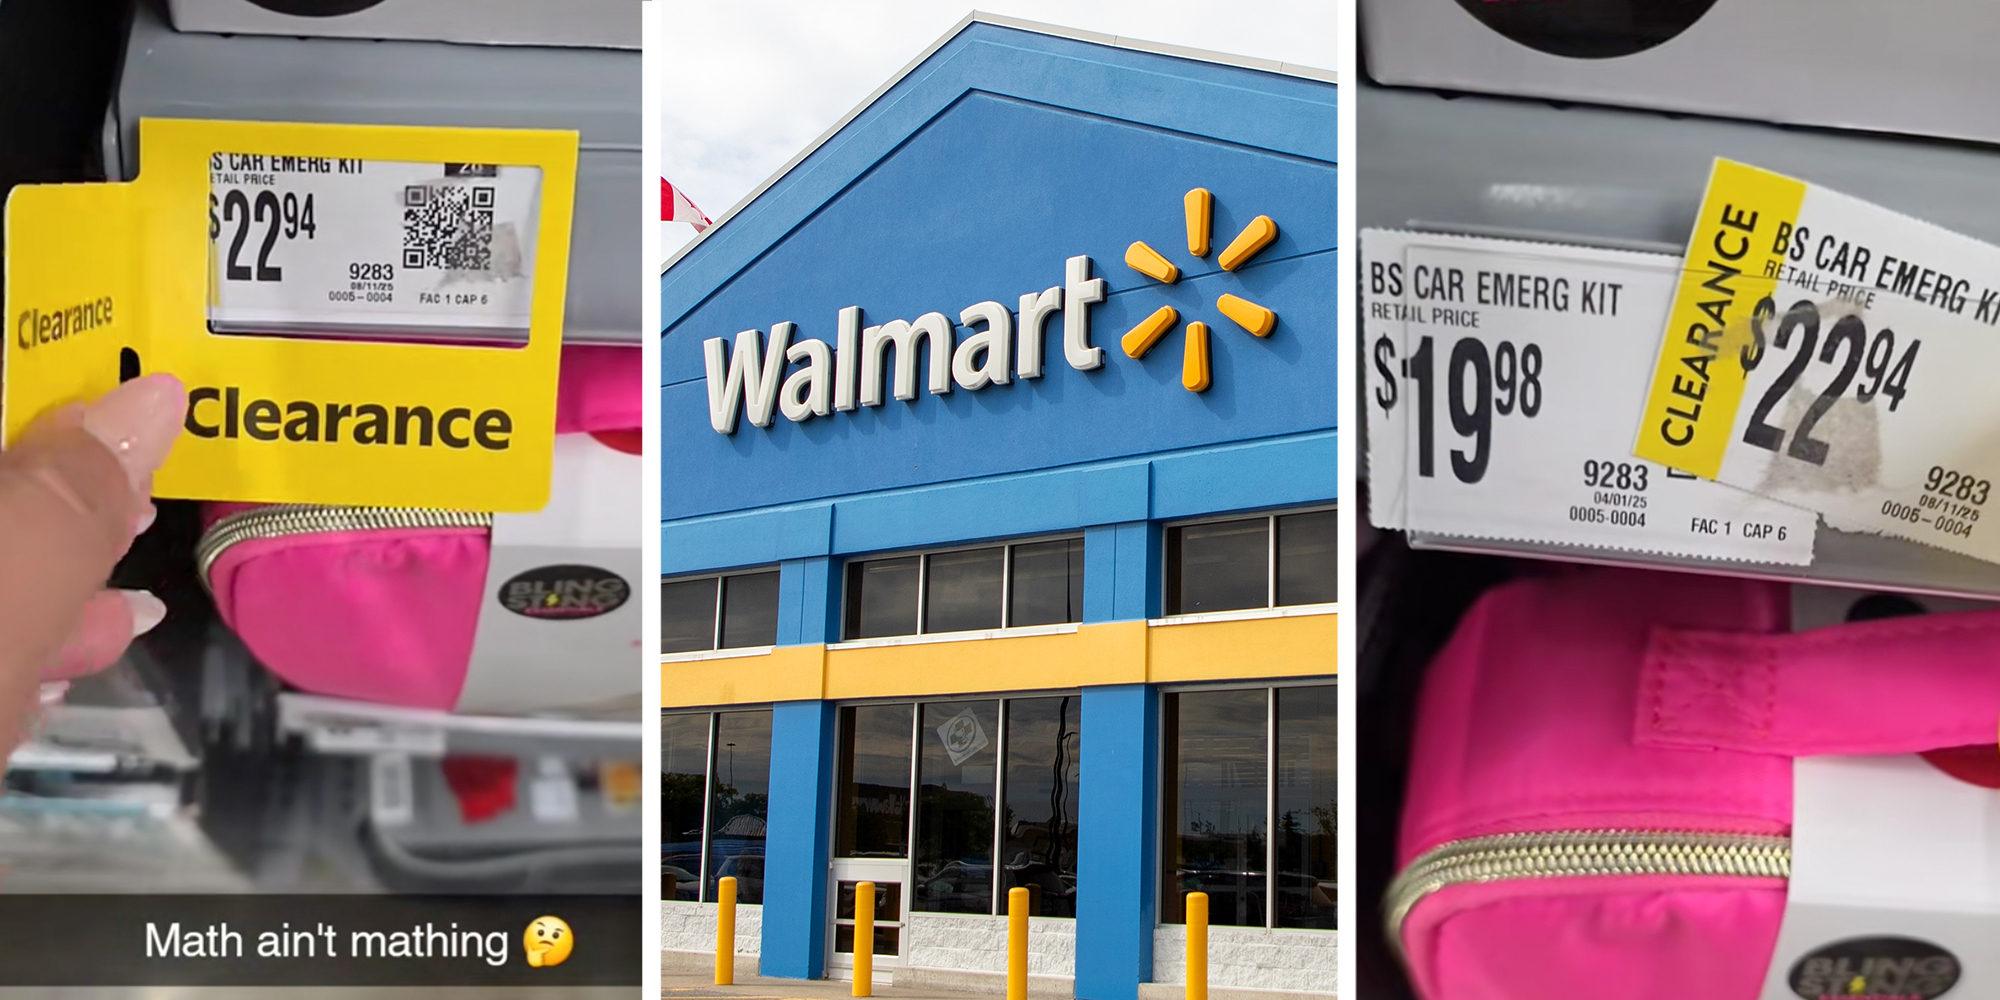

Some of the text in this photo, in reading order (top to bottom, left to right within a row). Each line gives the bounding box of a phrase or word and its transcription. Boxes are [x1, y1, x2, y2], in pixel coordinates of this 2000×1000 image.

[209, 152, 223, 171] S
[229, 153, 264, 172] CAR
[209, 173, 276, 185] ETAIL PRICE
[349, 263, 394, 281] 9283
[1763, 260, 1876, 310] RETAIL PRICE
[1772, 221, 2000, 326] BS CAR EMERG KI
[419, 293, 488, 305] FAC 1 CAP 6
[1371, 261, 1623, 316] BS CAR EMERG KIT
[18, 296, 113, 350] Clearance
[1371, 302, 1480, 328] RETAIL PRICE
[1660, 203, 1759, 447] CLEARANCE
[703, 254, 1106, 435] Walmart
[184, 387, 513, 450] Clearance
[1583, 459, 1649, 491] 9283
[1924, 465, 1991, 506] 9283
[1594, 491, 1648, 509] 04/01/25
[1569, 506, 1646, 527] 0005-0004
[1691, 518, 1787, 541] FAC 1 CAP 6
[509, 578, 624, 595] BLING
[1803, 956, 1954, 977] BLING
